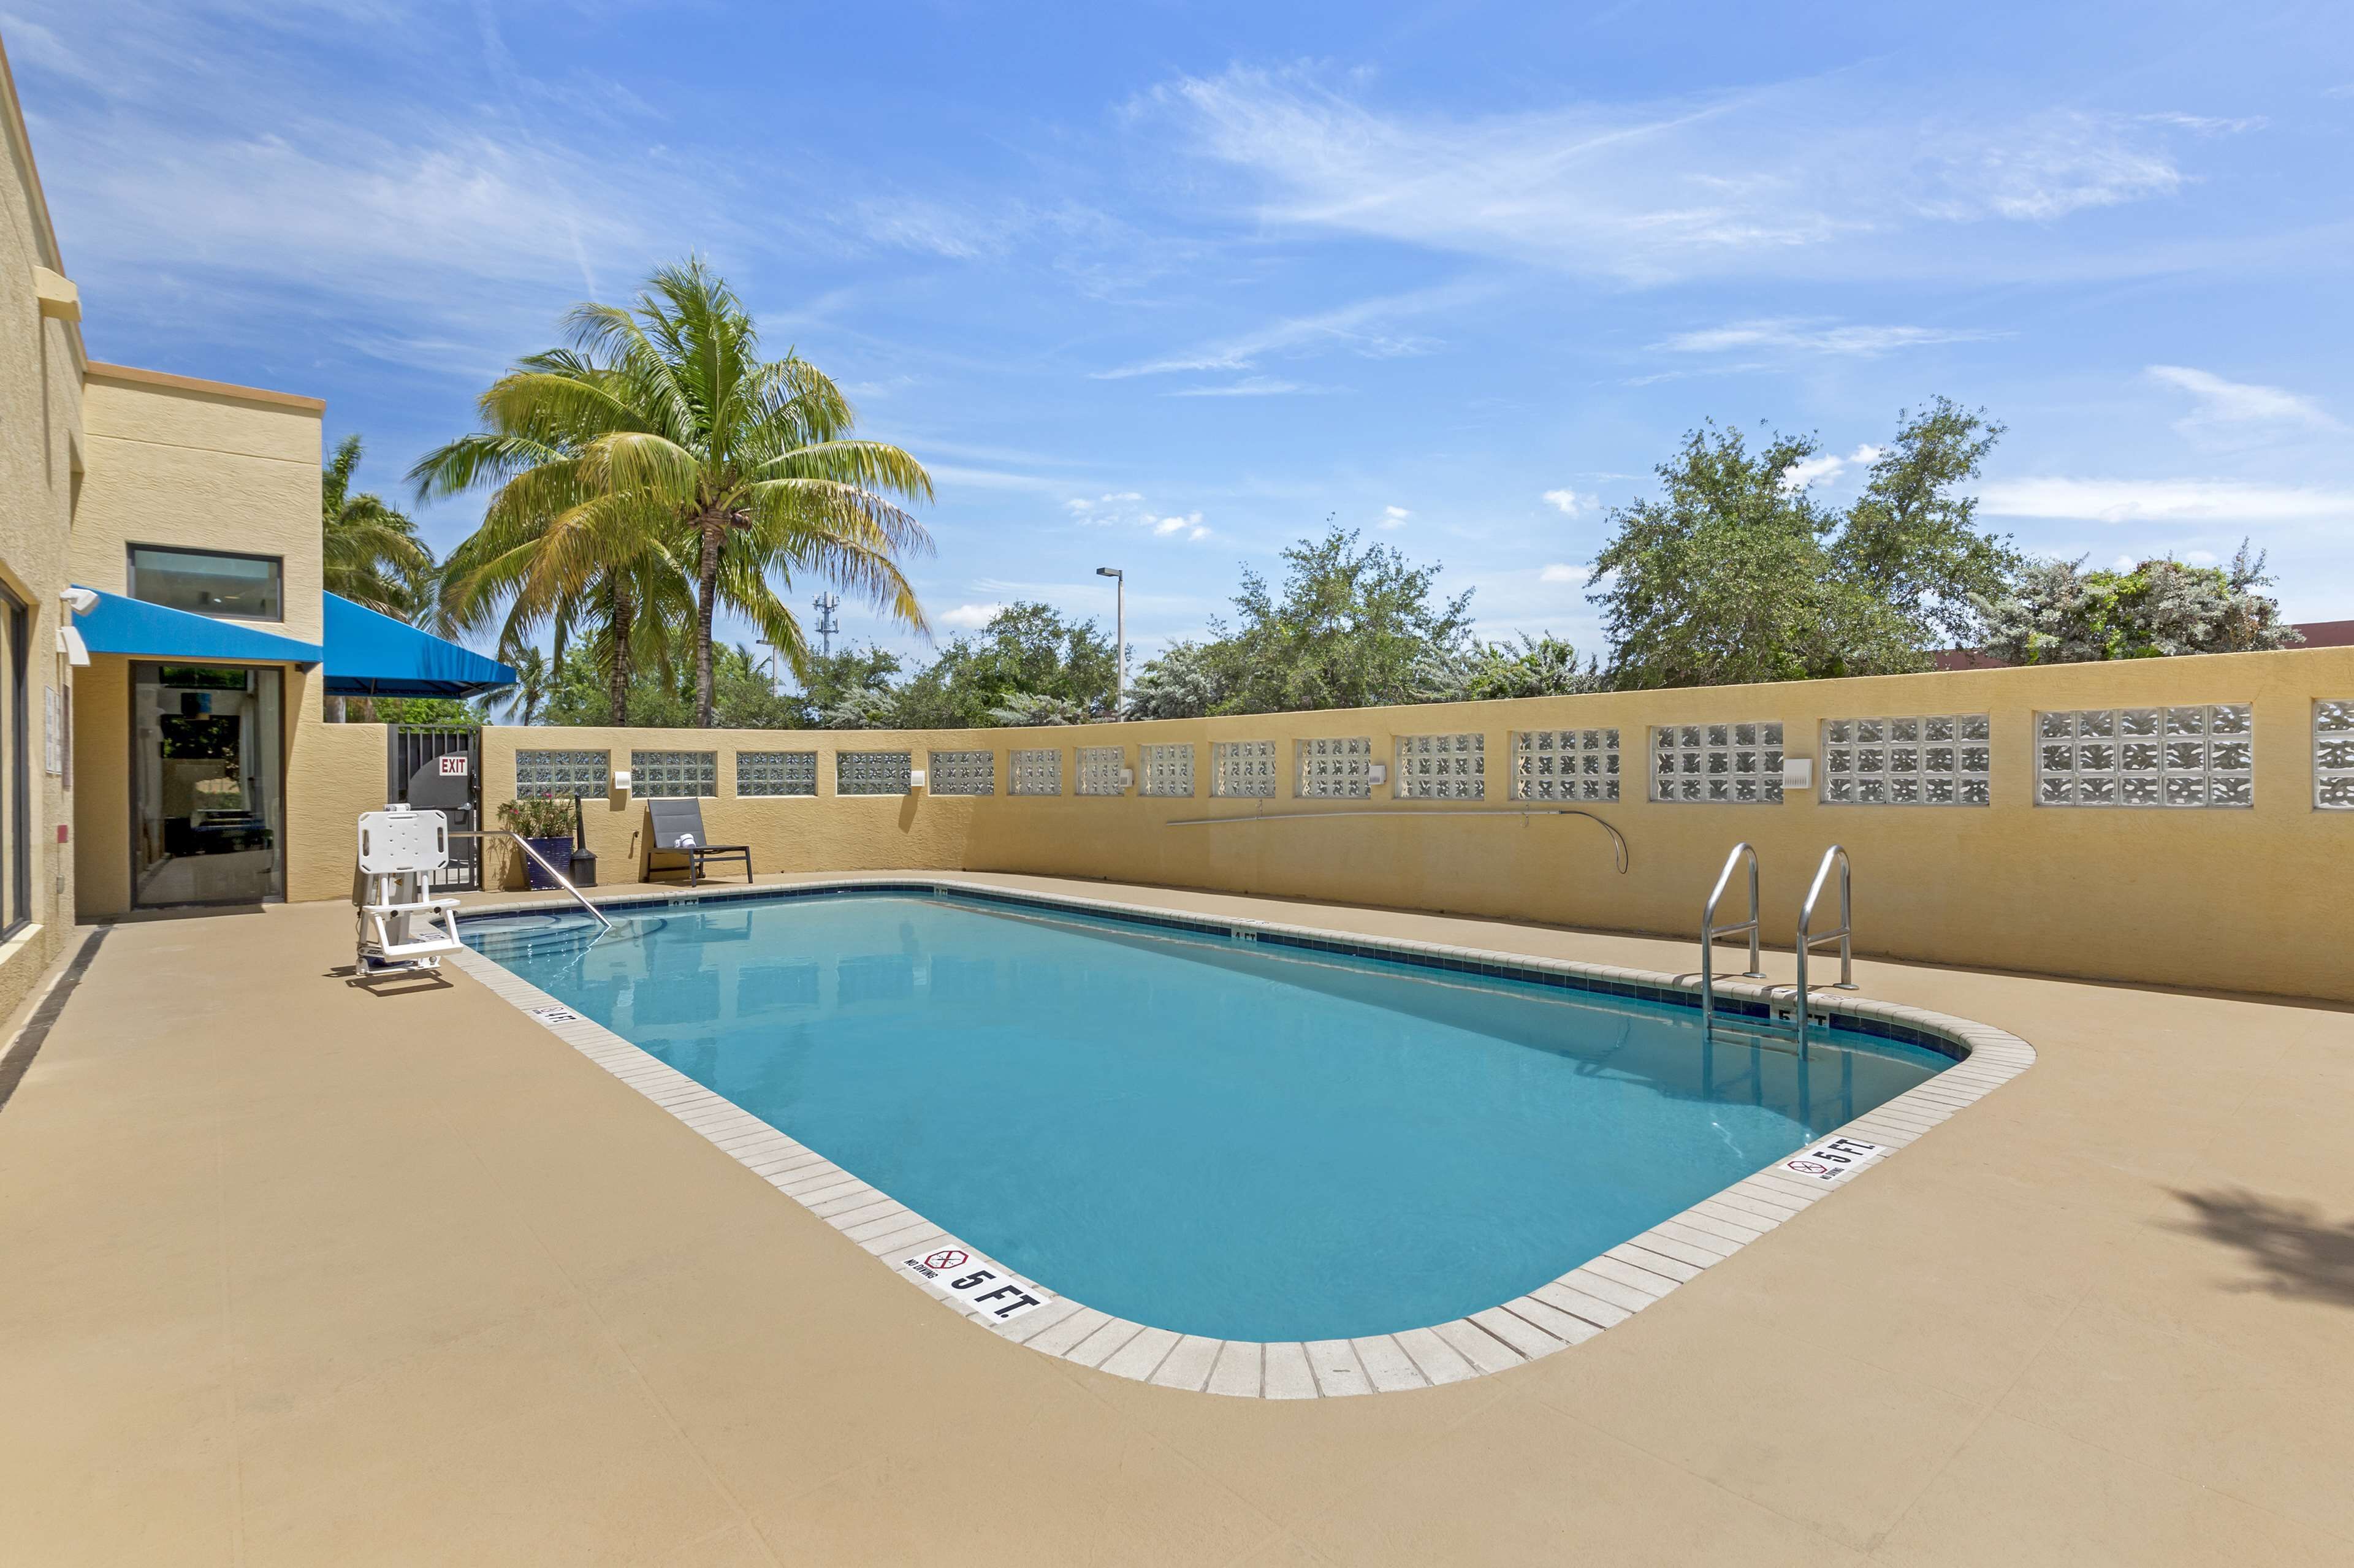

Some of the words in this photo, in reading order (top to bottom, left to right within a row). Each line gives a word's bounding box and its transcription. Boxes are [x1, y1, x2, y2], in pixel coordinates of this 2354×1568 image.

[442, 759, 465, 772] EXIT
[1827, 1138, 1876, 1155] FT.
[1812, 1151, 1852, 1163] 5
[913, 1264, 939, 1279] DIVING
[951, 1270, 996, 1290] 5
[974, 1284, 1040, 1318] FT.
